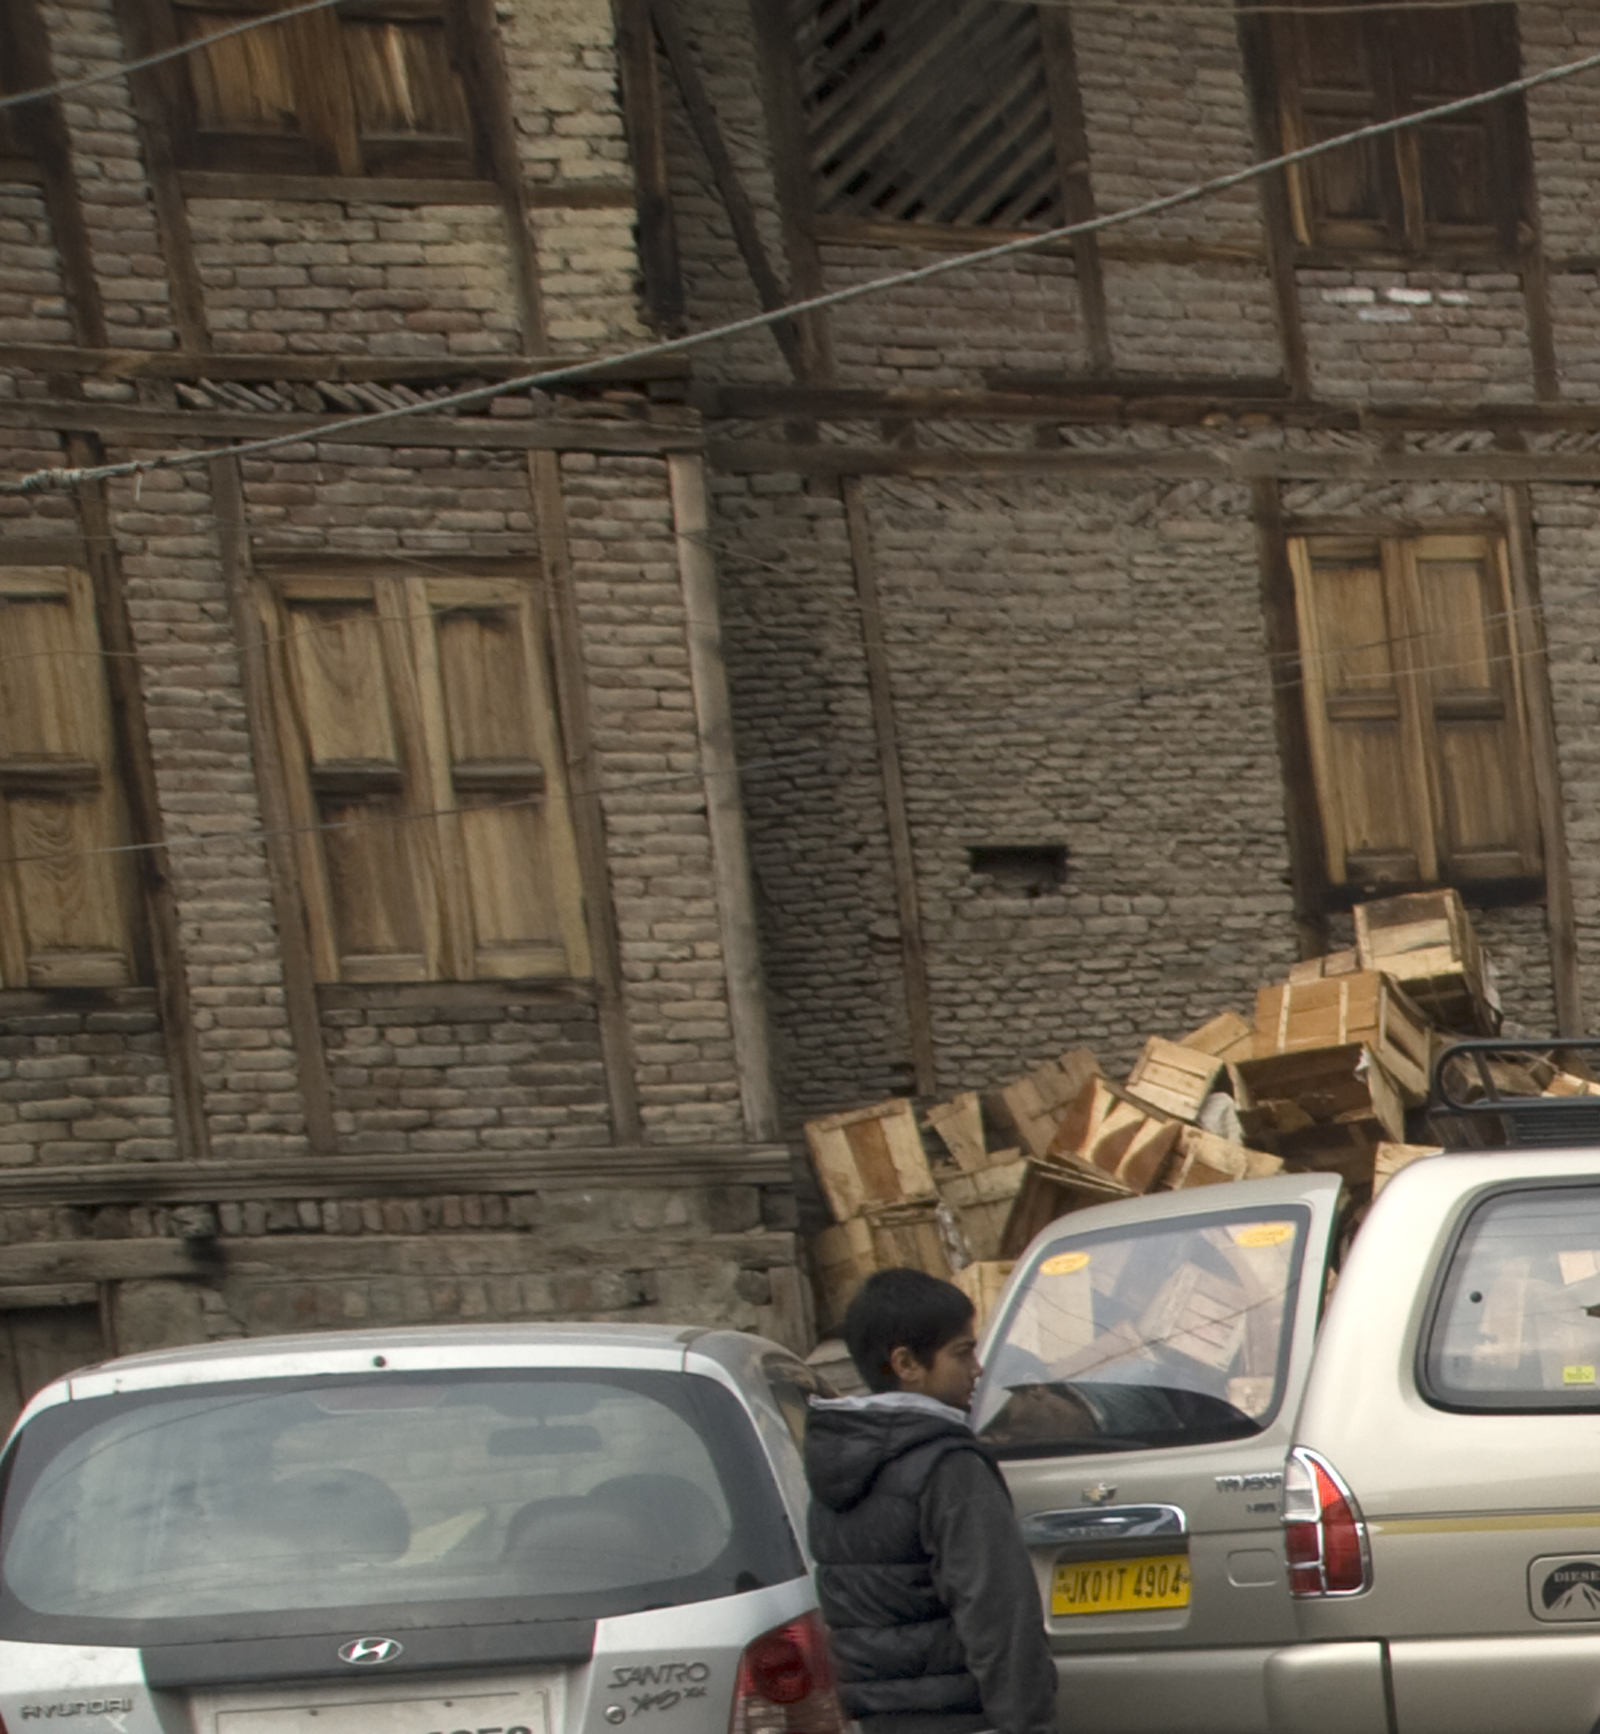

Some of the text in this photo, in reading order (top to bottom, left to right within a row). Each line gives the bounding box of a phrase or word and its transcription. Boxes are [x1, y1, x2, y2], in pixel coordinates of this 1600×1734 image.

[1067, 1567, 1128, 1603] JK01T
[607, 1661, 710, 1689] SANTRO
[20, 1698, 133, 1721] HYUNDAI
